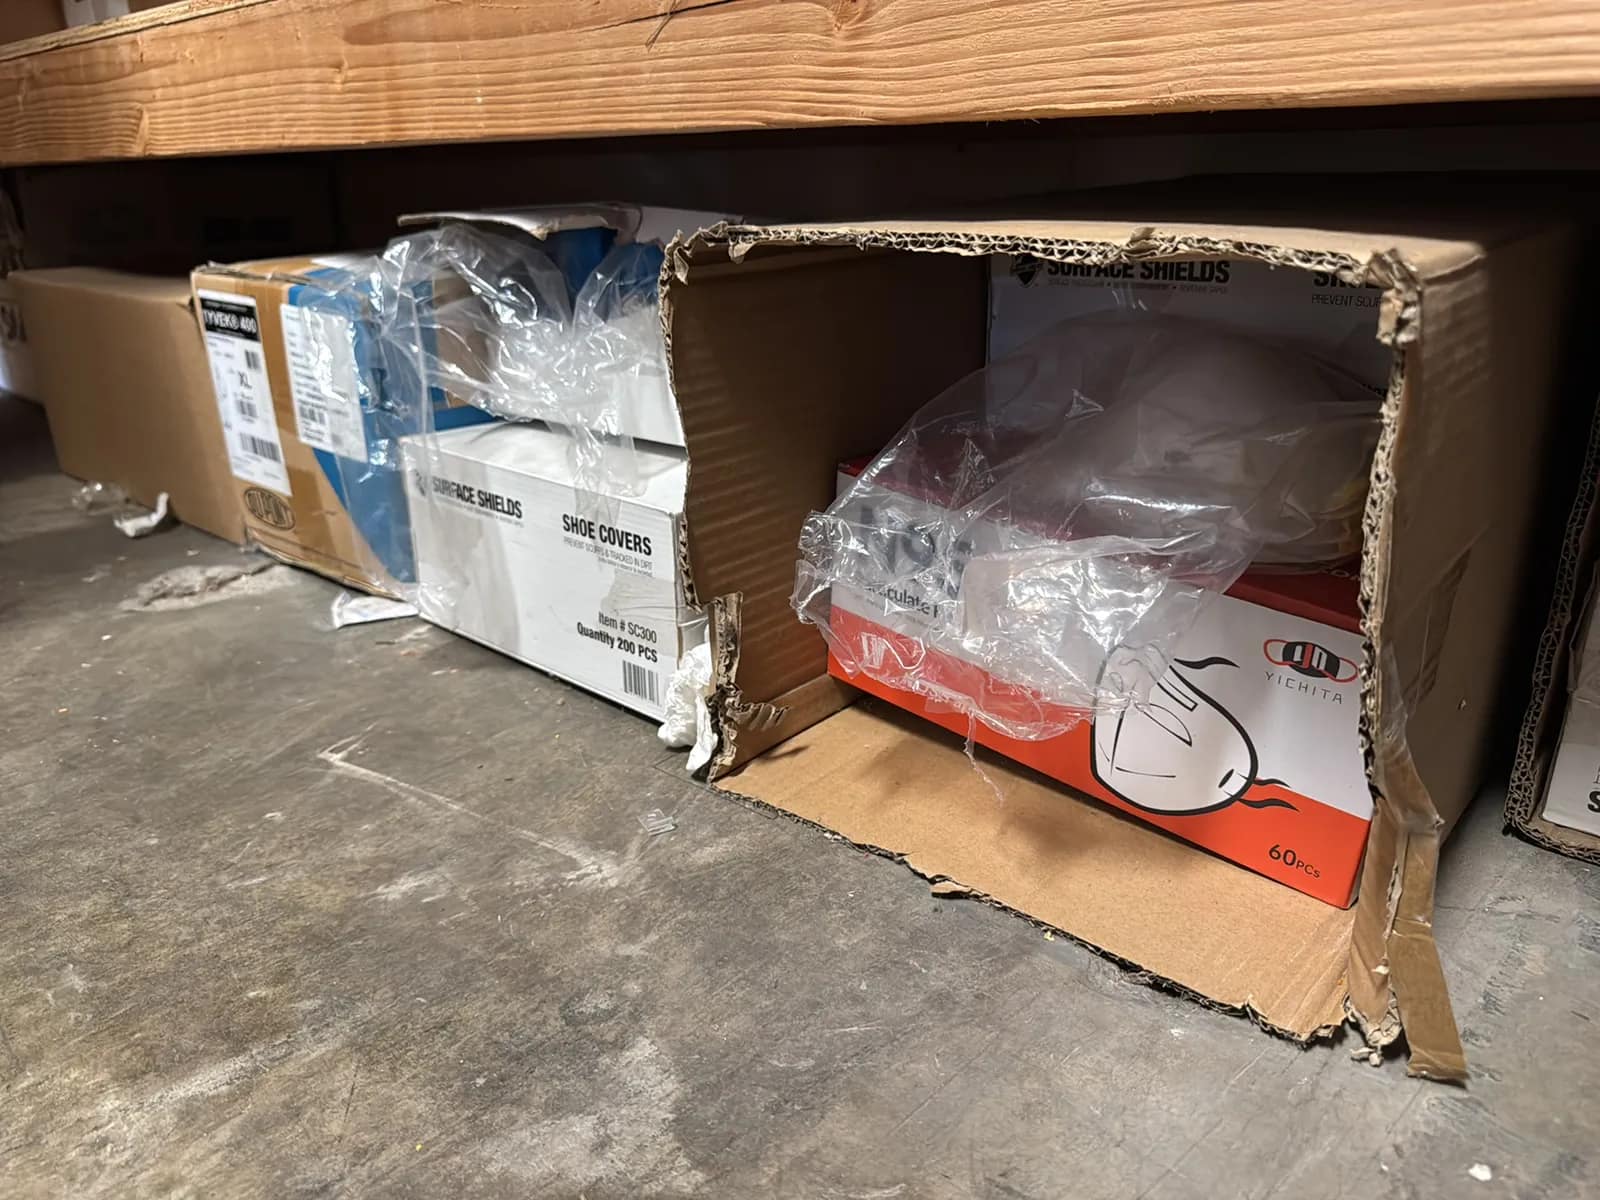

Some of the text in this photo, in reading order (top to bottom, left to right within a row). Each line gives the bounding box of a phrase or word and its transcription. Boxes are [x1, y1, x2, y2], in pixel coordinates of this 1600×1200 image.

[1140, 260, 1230, 283] SHIELDS
[1312, 294, 1381, 308] PREVENT SCUF
[240, 316, 257, 333] 400
[237, 371, 252, 389] XL
[432, 476, 476, 505] SURFACE
[477, 489, 523, 519] SHIELDS
[562, 513, 652, 556] SHOE COVERS
[577, 621, 658, 663] Quantity 200 PCS
[598, 611, 657, 643] Item # SC300
[1265, 671, 1343, 704] YICHITA
